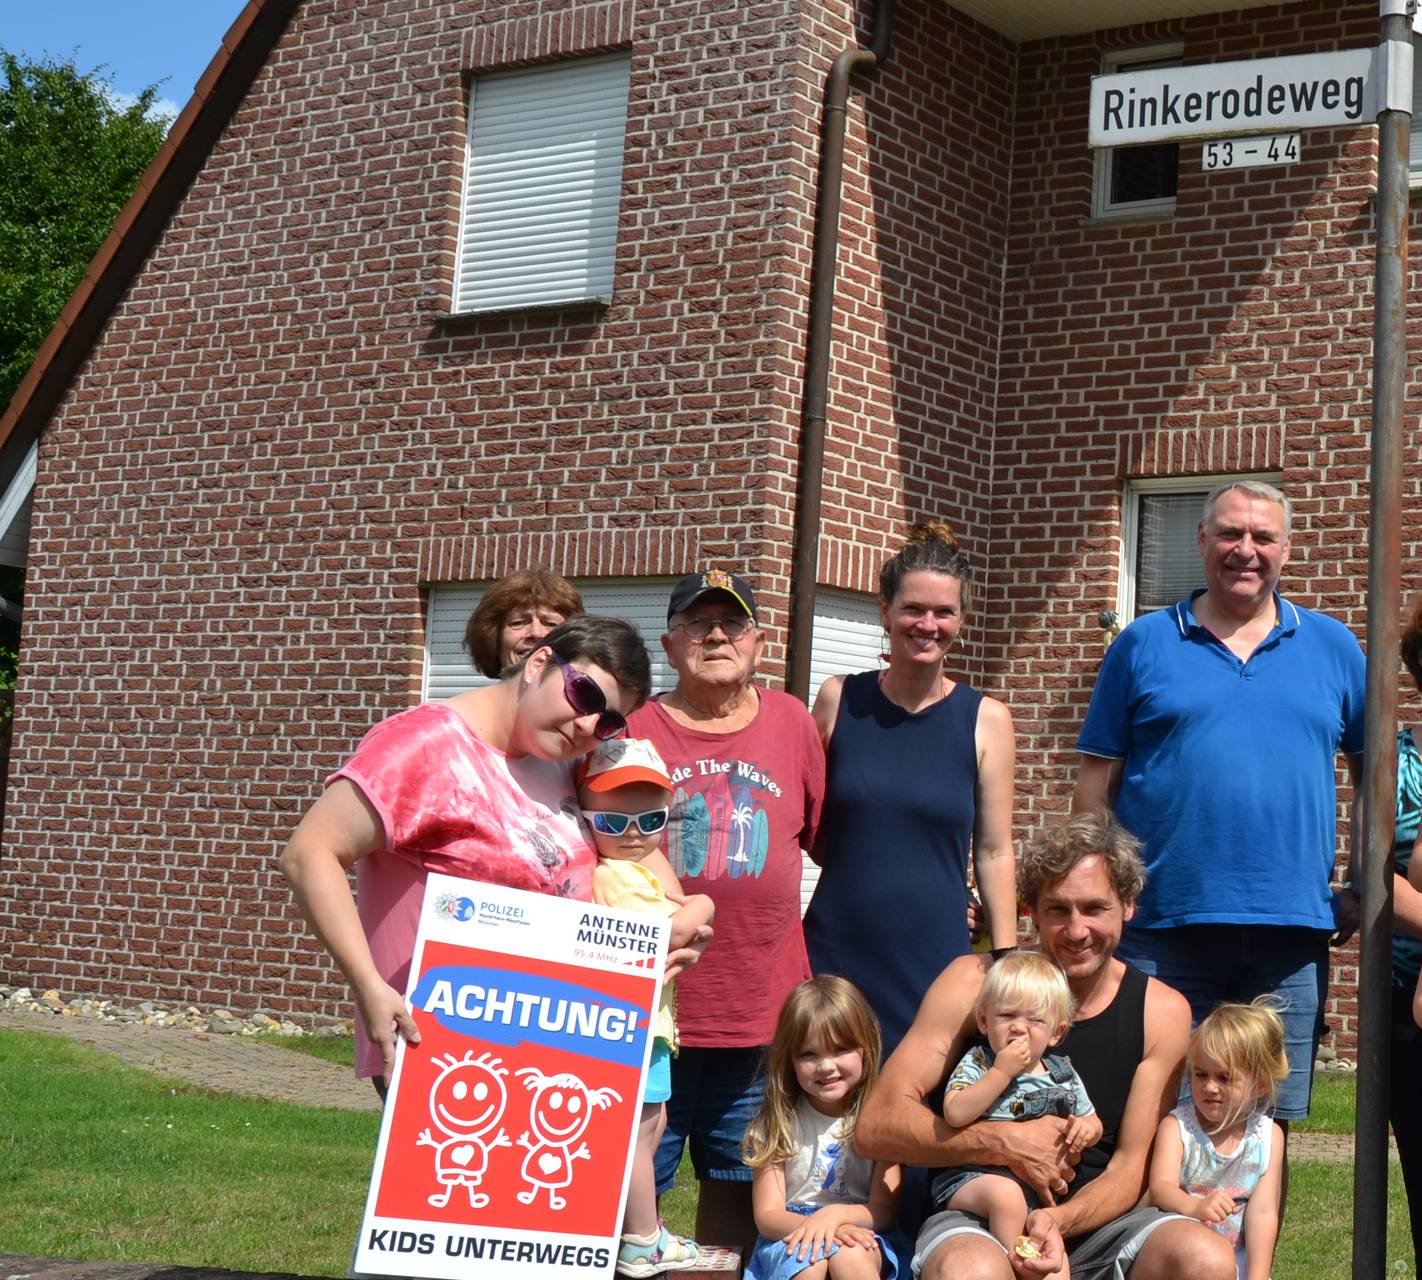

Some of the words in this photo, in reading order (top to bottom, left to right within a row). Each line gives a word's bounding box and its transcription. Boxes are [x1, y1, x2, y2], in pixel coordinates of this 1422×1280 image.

[1103, 75, 1364, 131] Rinkerodeweg
[1207, 141, 1233, 168] 53
[1268, 135, 1297, 161] 44
[696, 759, 731, 776] The
[737, 760, 783, 798] Waves
[480, 901, 524, 918] POLIZEI
[579, 913, 660, 939] ANTENNE
[574, 948, 595, 960] 95.4
[597, 952, 618, 964] MHz
[576, 929, 658, 954] MÜNSTER
[422, 979, 639, 1044] ACHTUNG!
[368, 1229, 436, 1255] KIDS
[445, 1235, 611, 1268] UNTERWEGS
